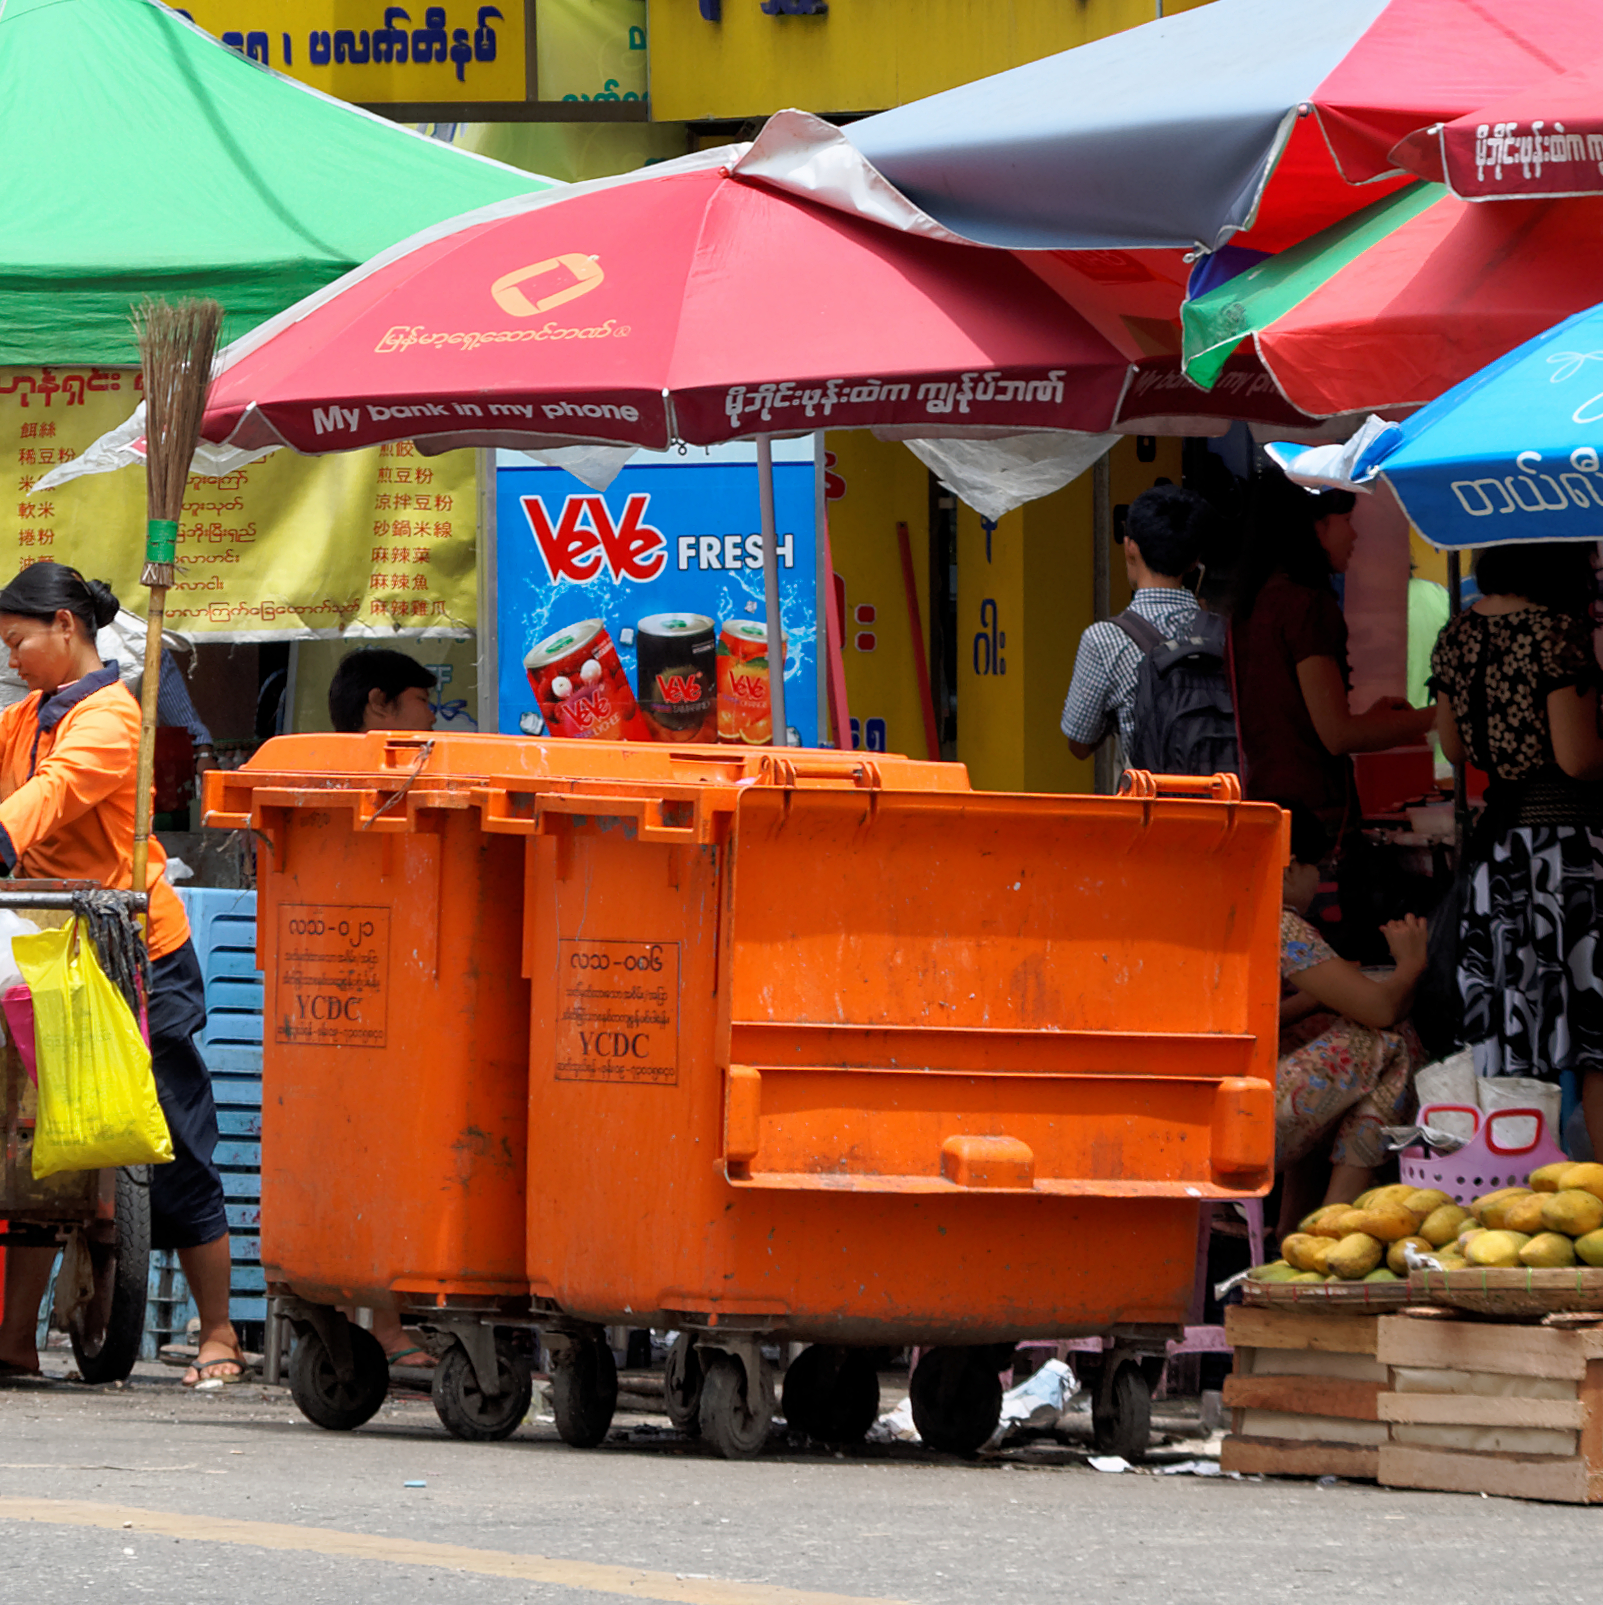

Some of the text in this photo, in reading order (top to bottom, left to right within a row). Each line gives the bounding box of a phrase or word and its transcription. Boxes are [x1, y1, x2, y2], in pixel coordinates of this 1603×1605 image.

[311, 395, 640, 436] My bank in my phone
[677, 533, 795, 571] FRESH
[297, 994, 363, 1021] YCDC
[579, 1031, 650, 1058] YCDC
